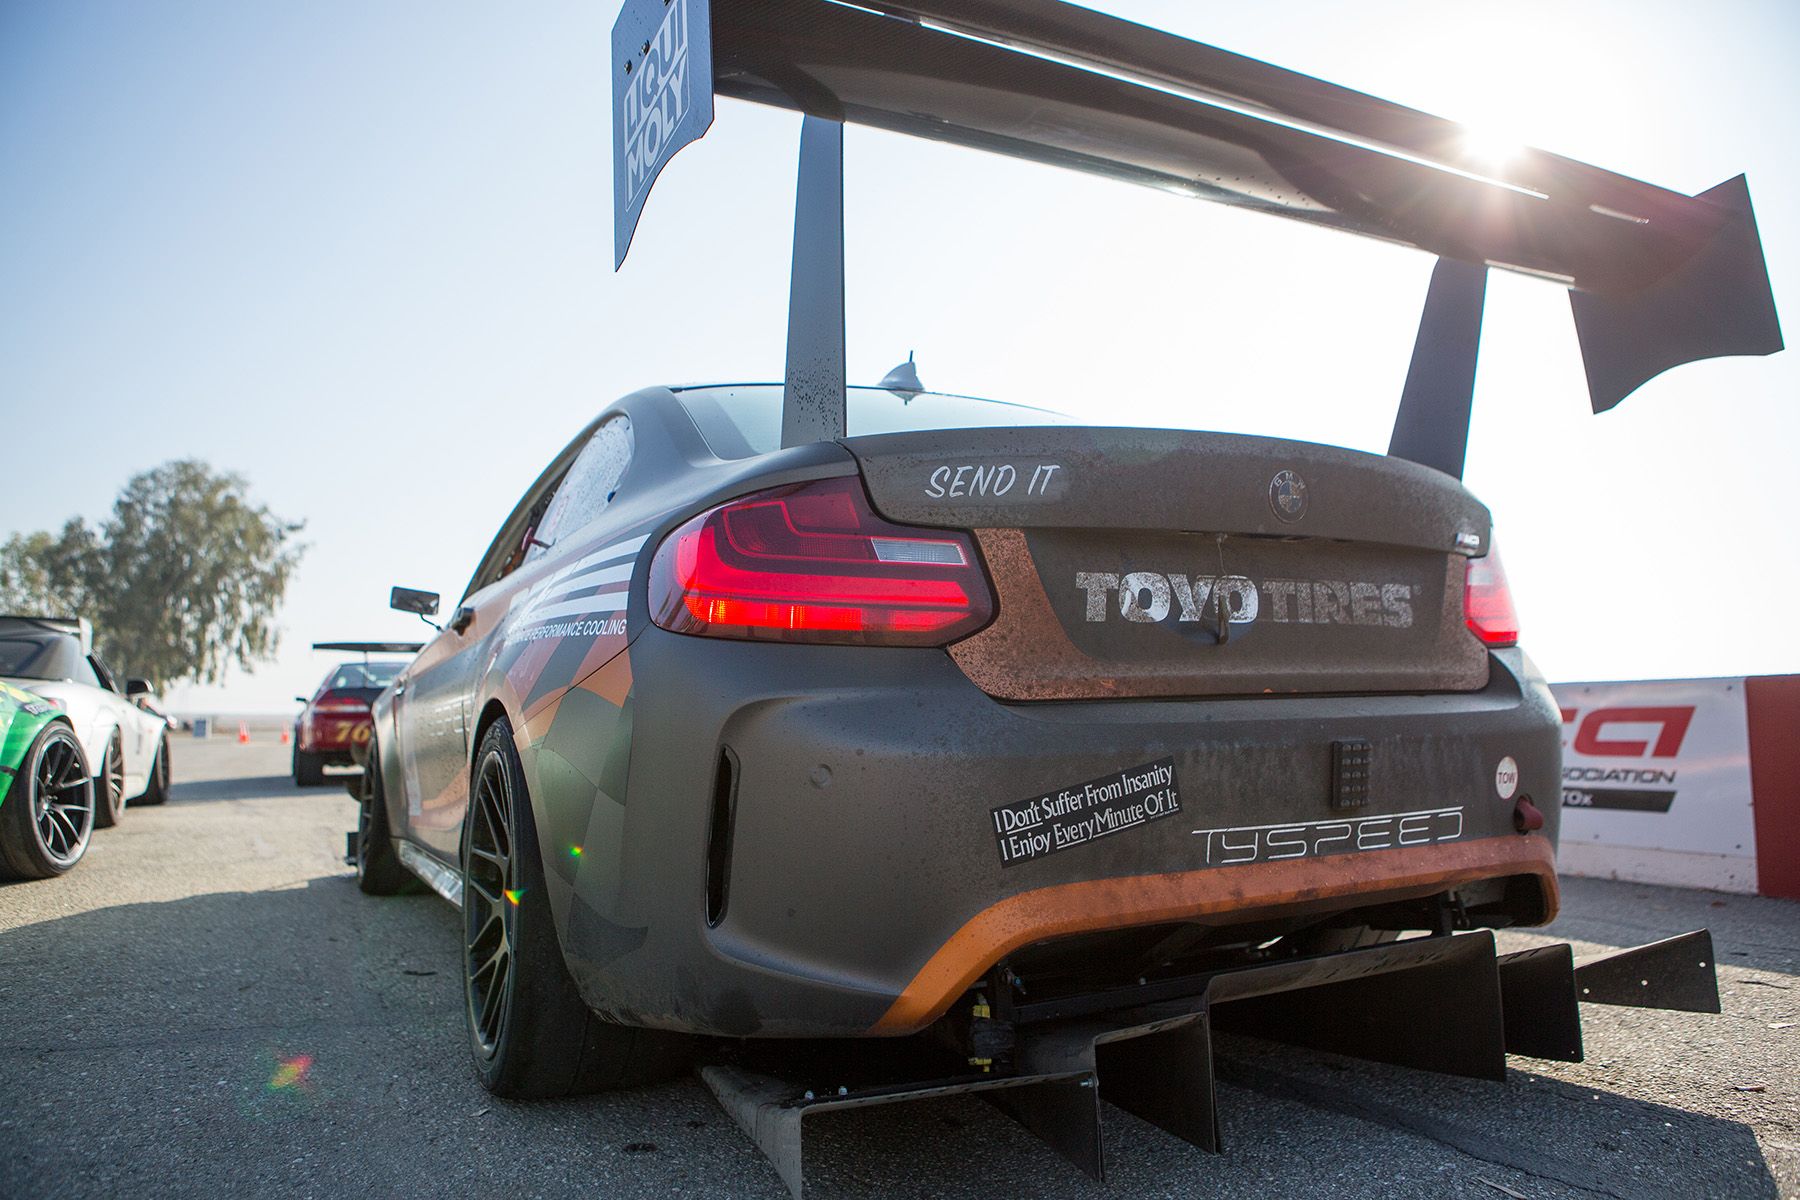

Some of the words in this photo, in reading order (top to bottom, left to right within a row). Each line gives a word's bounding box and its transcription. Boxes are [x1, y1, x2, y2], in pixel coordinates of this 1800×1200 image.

[627, 53, 687, 202] MOLY
[925, 464, 1017, 498] SEND
[1027, 464, 1061, 496] IT
[583, 618, 627, 636] COOLING
[1075, 571, 1260, 624] TOYO
[1262, 577, 1414, 629] TIRES
[335, 720, 371, 742] 76
[993, 811, 1002, 833] I
[1002, 801, 1043, 832] Don't
[1041, 790, 1084, 820] Suffer
[1084, 783, 1123, 807] From
[1122, 764, 1173, 795] Insanity
[1498, 771, 1515, 784] TOW
[1000, 839, 1009, 861] I
[1009, 831, 1051, 858] Enjoy
[1053, 818, 1095, 845] Every
[1094, 803, 1145, 833] Minute
[1144, 792, 1164, 816] Of
[1166, 788, 1179, 810] It
[1191, 806, 1464, 864] TYSPEED
